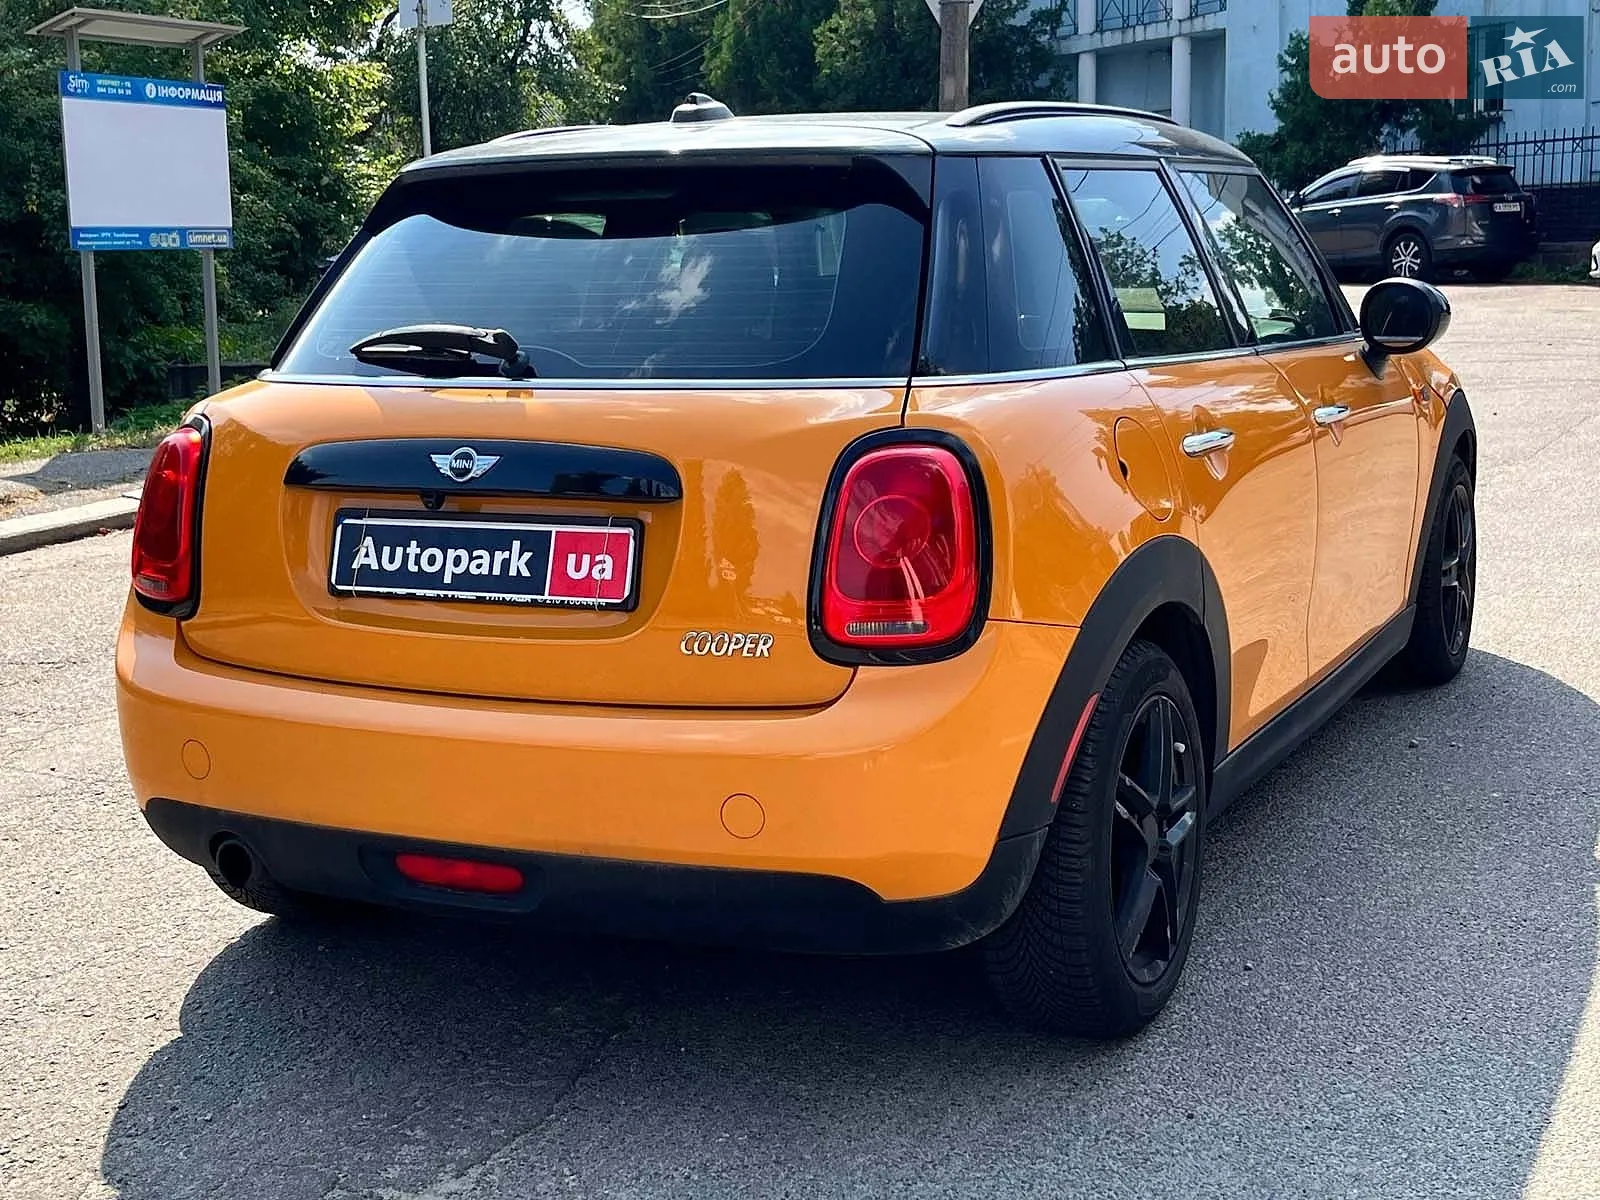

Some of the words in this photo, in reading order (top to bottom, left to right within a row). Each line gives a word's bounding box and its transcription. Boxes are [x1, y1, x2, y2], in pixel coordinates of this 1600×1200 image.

[157, 85, 223, 104] ІНФОРМАЦІЯ
[188, 231, 227, 244] simnet.ua
[451, 458, 473, 470] MINI
[351, 535, 533, 584] Autopark
[566, 552, 614, 581] ua
[680, 631, 774, 658] COOPER
